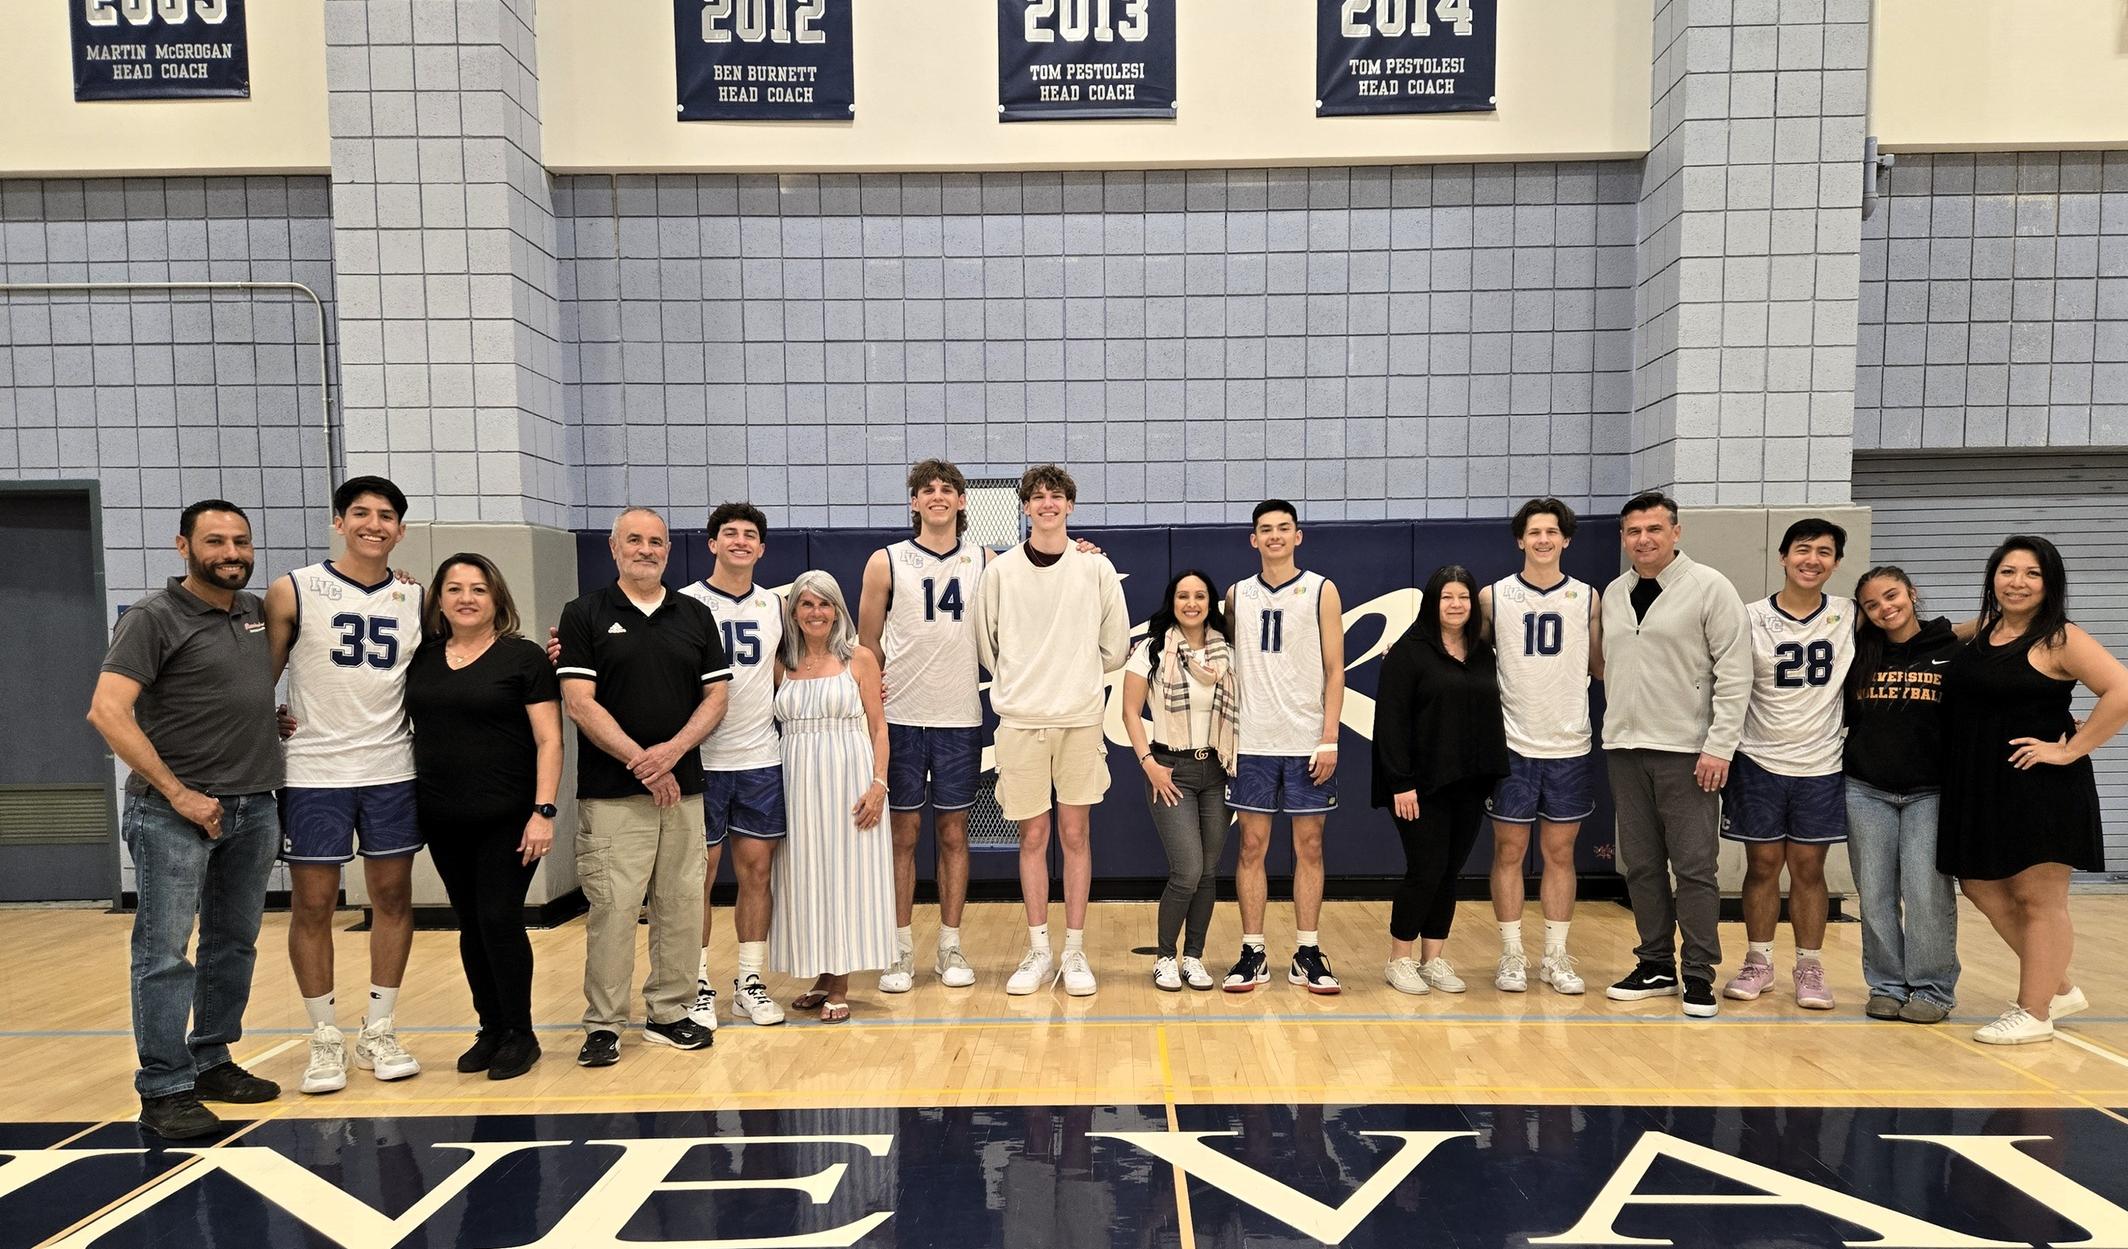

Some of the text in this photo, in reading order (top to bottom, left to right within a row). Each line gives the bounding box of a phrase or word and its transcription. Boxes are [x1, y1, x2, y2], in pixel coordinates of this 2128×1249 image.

[701, 0, 826, 43] 2012
[1024, 0, 1149, 42] 2013
[1341, 0, 1473, 37] 2014
[86, 44, 147, 61] MARTIN
[112, 63, 209, 80] HEAD COACH
[713, 65, 817, 82] BEN BURNETT
[1029, 62, 1145, 81] TOM PESTOLESI
[1349, 57, 1465, 75] TOM PESTOLESI
[718, 86, 814, 103] HEAD COACH
[1039, 84, 1136, 102] HEAD COACH
[1358, 78, 1455, 96] HEAD COACH
[309, 576, 342, 601] IVC
[921, 576, 965, 622] 14
[1503, 584, 1526, 603] IVC
[330, 611, 399, 670] 35
[720, 619, 762, 667] 15
[1260, 608, 1284, 653] 11
[1523, 611, 1564, 656] 10
[1774, 638, 1835, 688] 28
